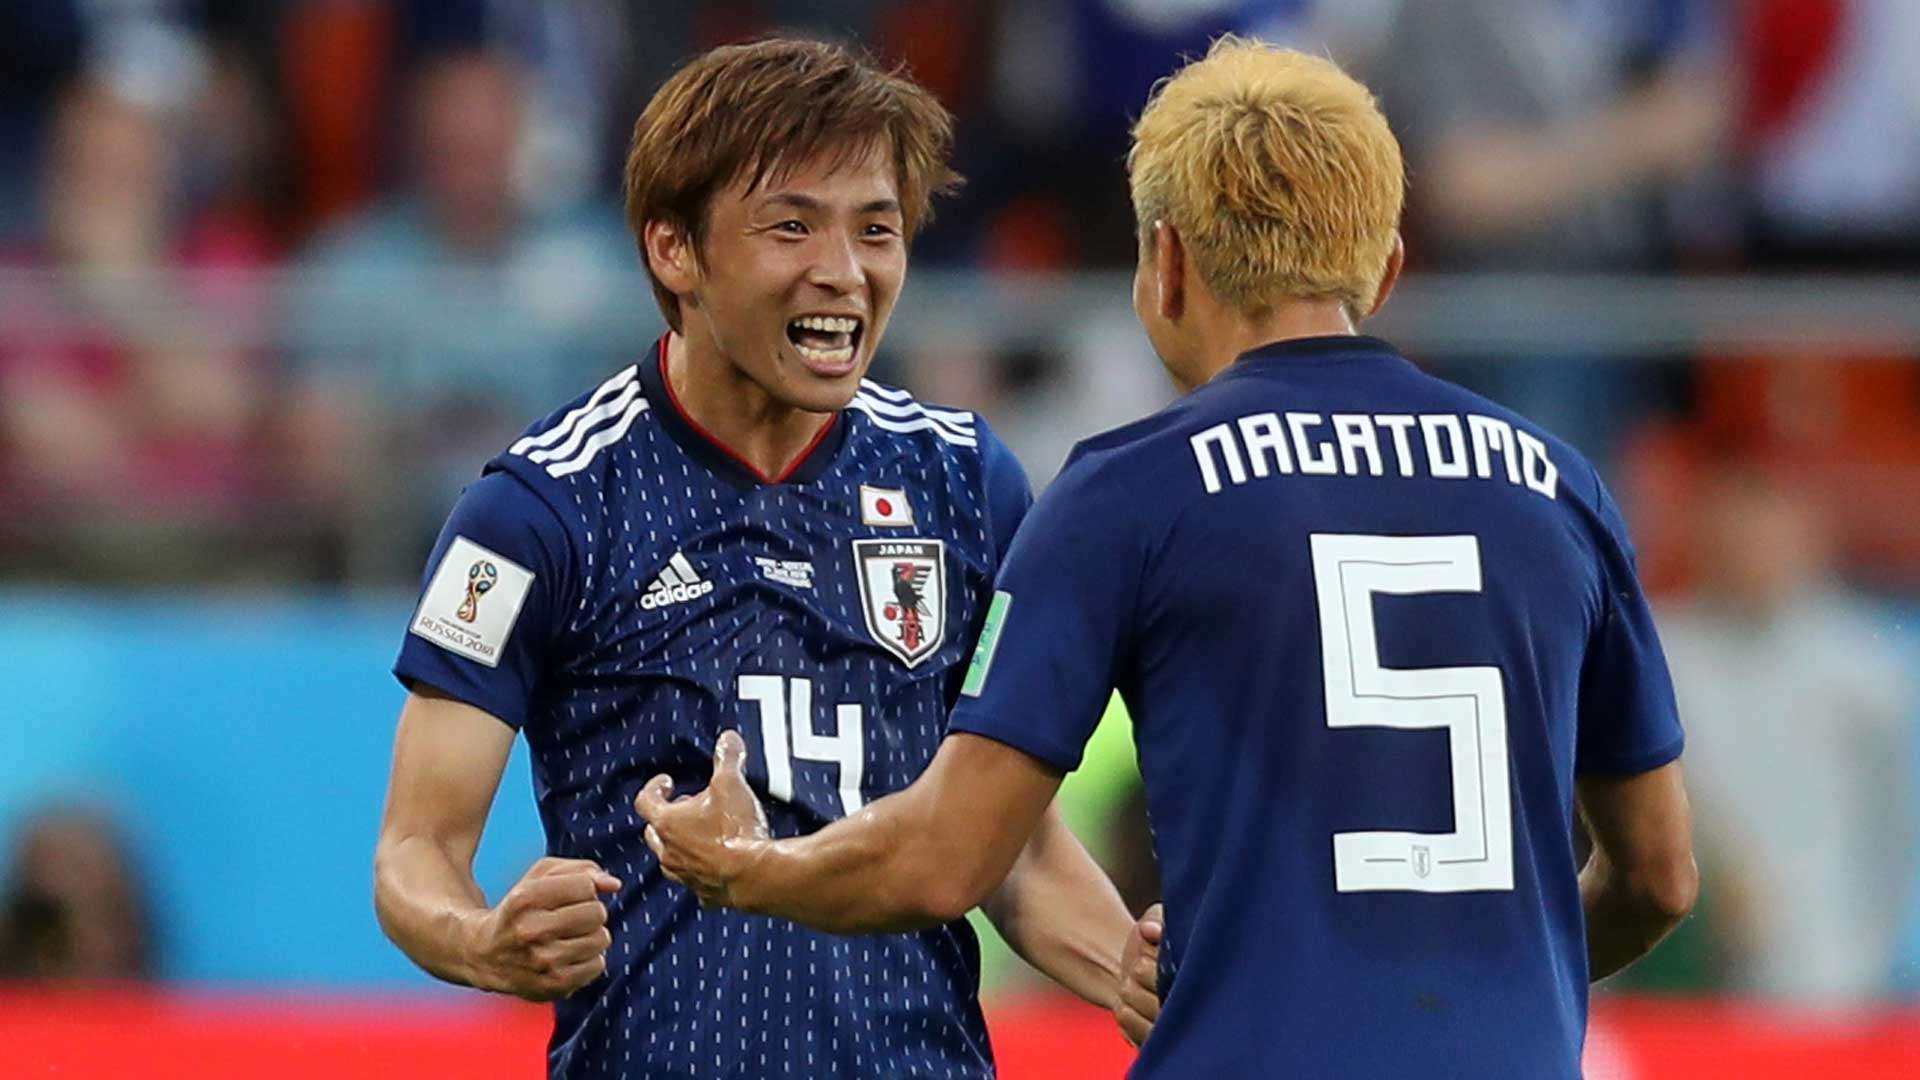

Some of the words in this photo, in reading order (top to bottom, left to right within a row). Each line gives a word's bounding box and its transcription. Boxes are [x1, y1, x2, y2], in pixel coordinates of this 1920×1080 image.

[1190, 412, 1558, 499] NAGATOMO
[878, 544, 924, 556] JAPAN
[640, 580, 713, 610] adidas
[420, 616, 464, 644] RUSSIA
[896, 622, 926, 643] JA
[1310, 533, 1515, 893] 5
[738, 675, 864, 817] 14
